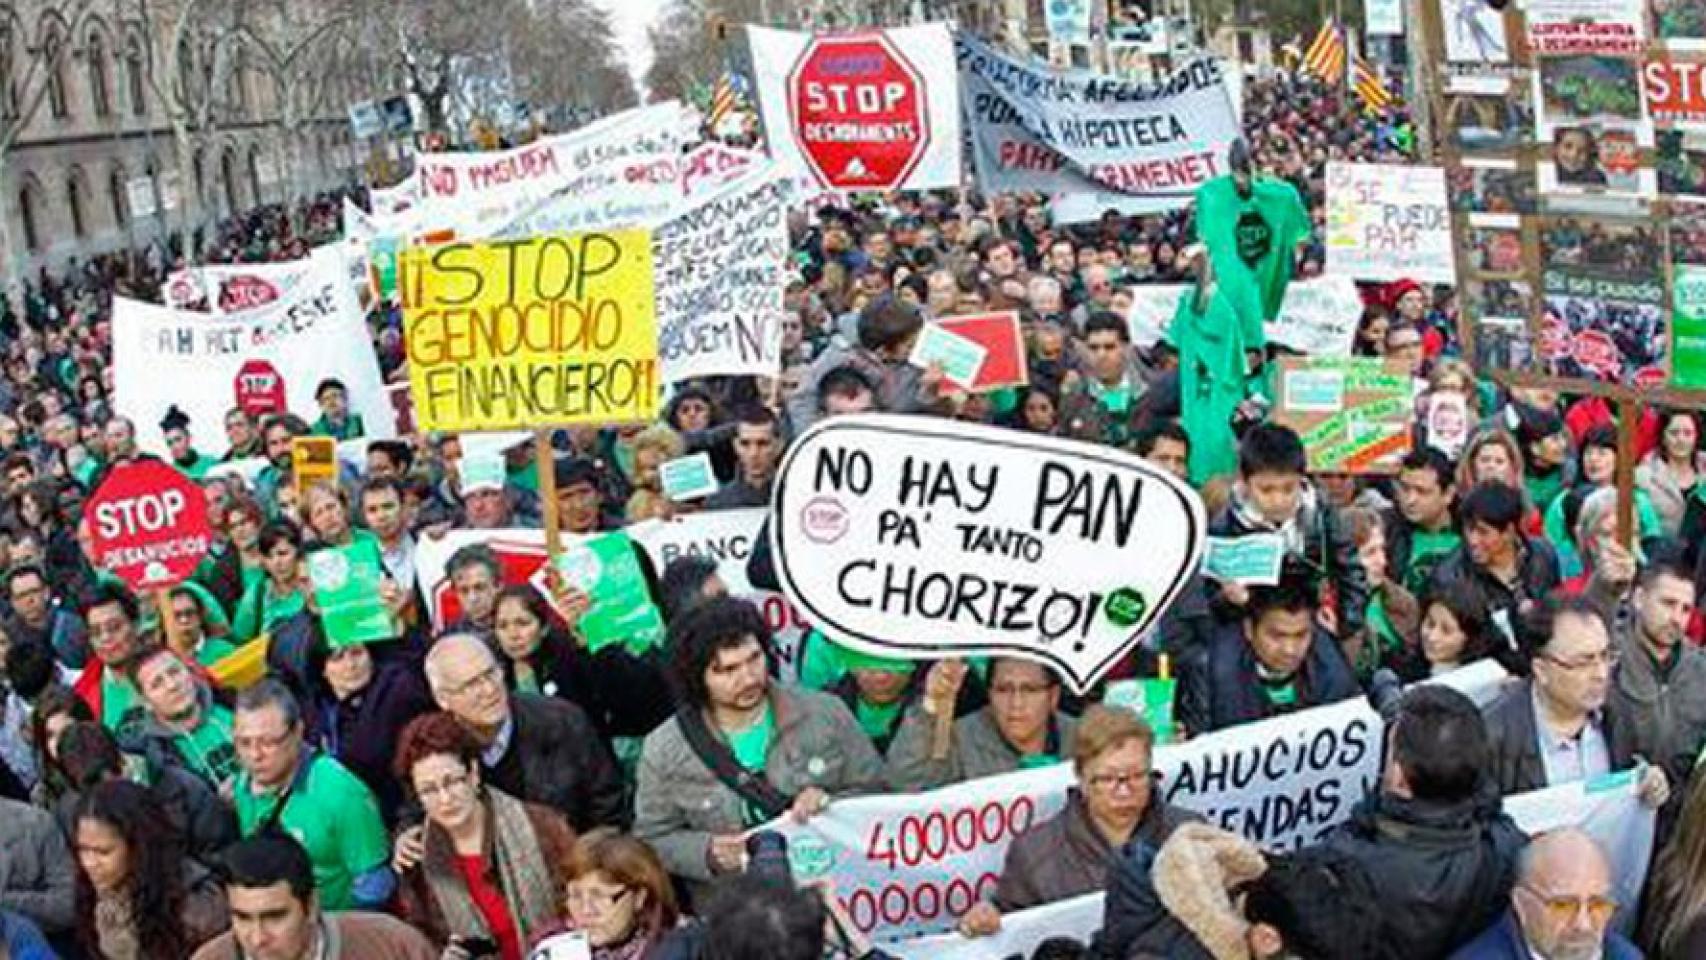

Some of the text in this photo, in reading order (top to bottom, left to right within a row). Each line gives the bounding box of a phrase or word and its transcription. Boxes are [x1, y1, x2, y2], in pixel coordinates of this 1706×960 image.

[807, 82, 906, 113] STOP
[1057, 115, 1187, 148] HIPOTECA
[419, 164, 457, 198] NO
[410, 298, 622, 367] GENOCIDIO
[96, 488, 186, 538] STOP
[815, 447, 1143, 548] NO HAY PAN
[956, 523, 1043, 563] TANTO
[837, 558, 1100, 653] CHORIZO!
